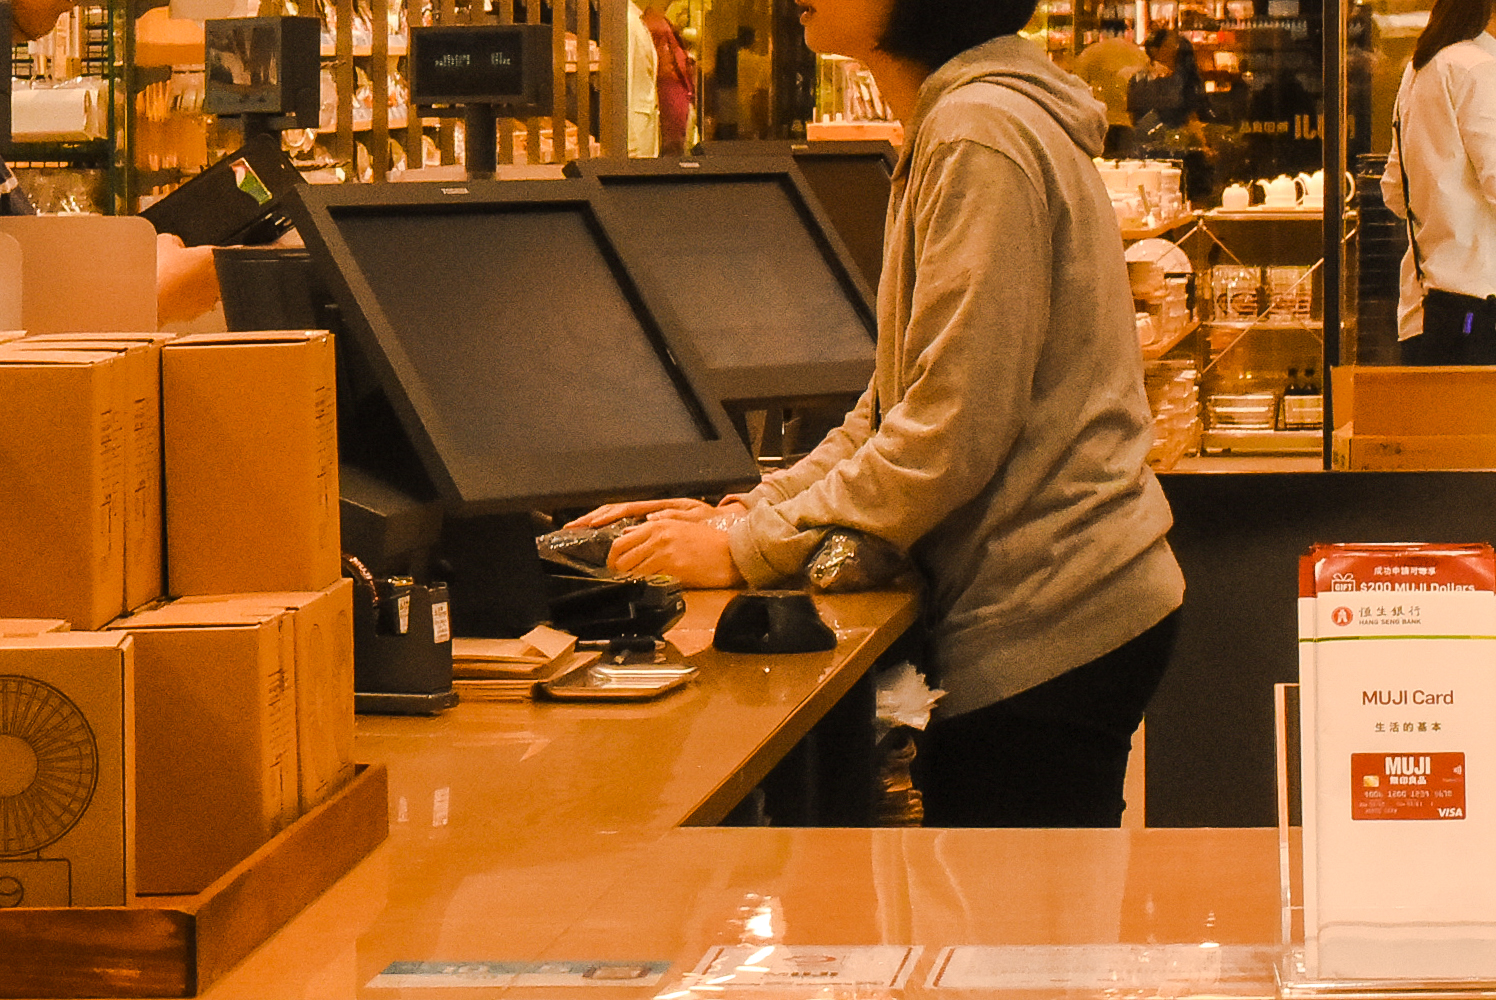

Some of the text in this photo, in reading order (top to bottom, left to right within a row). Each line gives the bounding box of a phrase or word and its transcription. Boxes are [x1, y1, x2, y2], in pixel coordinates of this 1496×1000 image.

[1334, 583, 1353, 591] GIFT
[1360, 581, 1475, 592] $200 MUJI Dollars
[1362, 689, 1454, 706] MUJI Card
[1374, 721, 1442, 733] 生活的基本
[1385, 756, 1431, 775] MUJI
[1437, 807, 1463, 818] VISA
